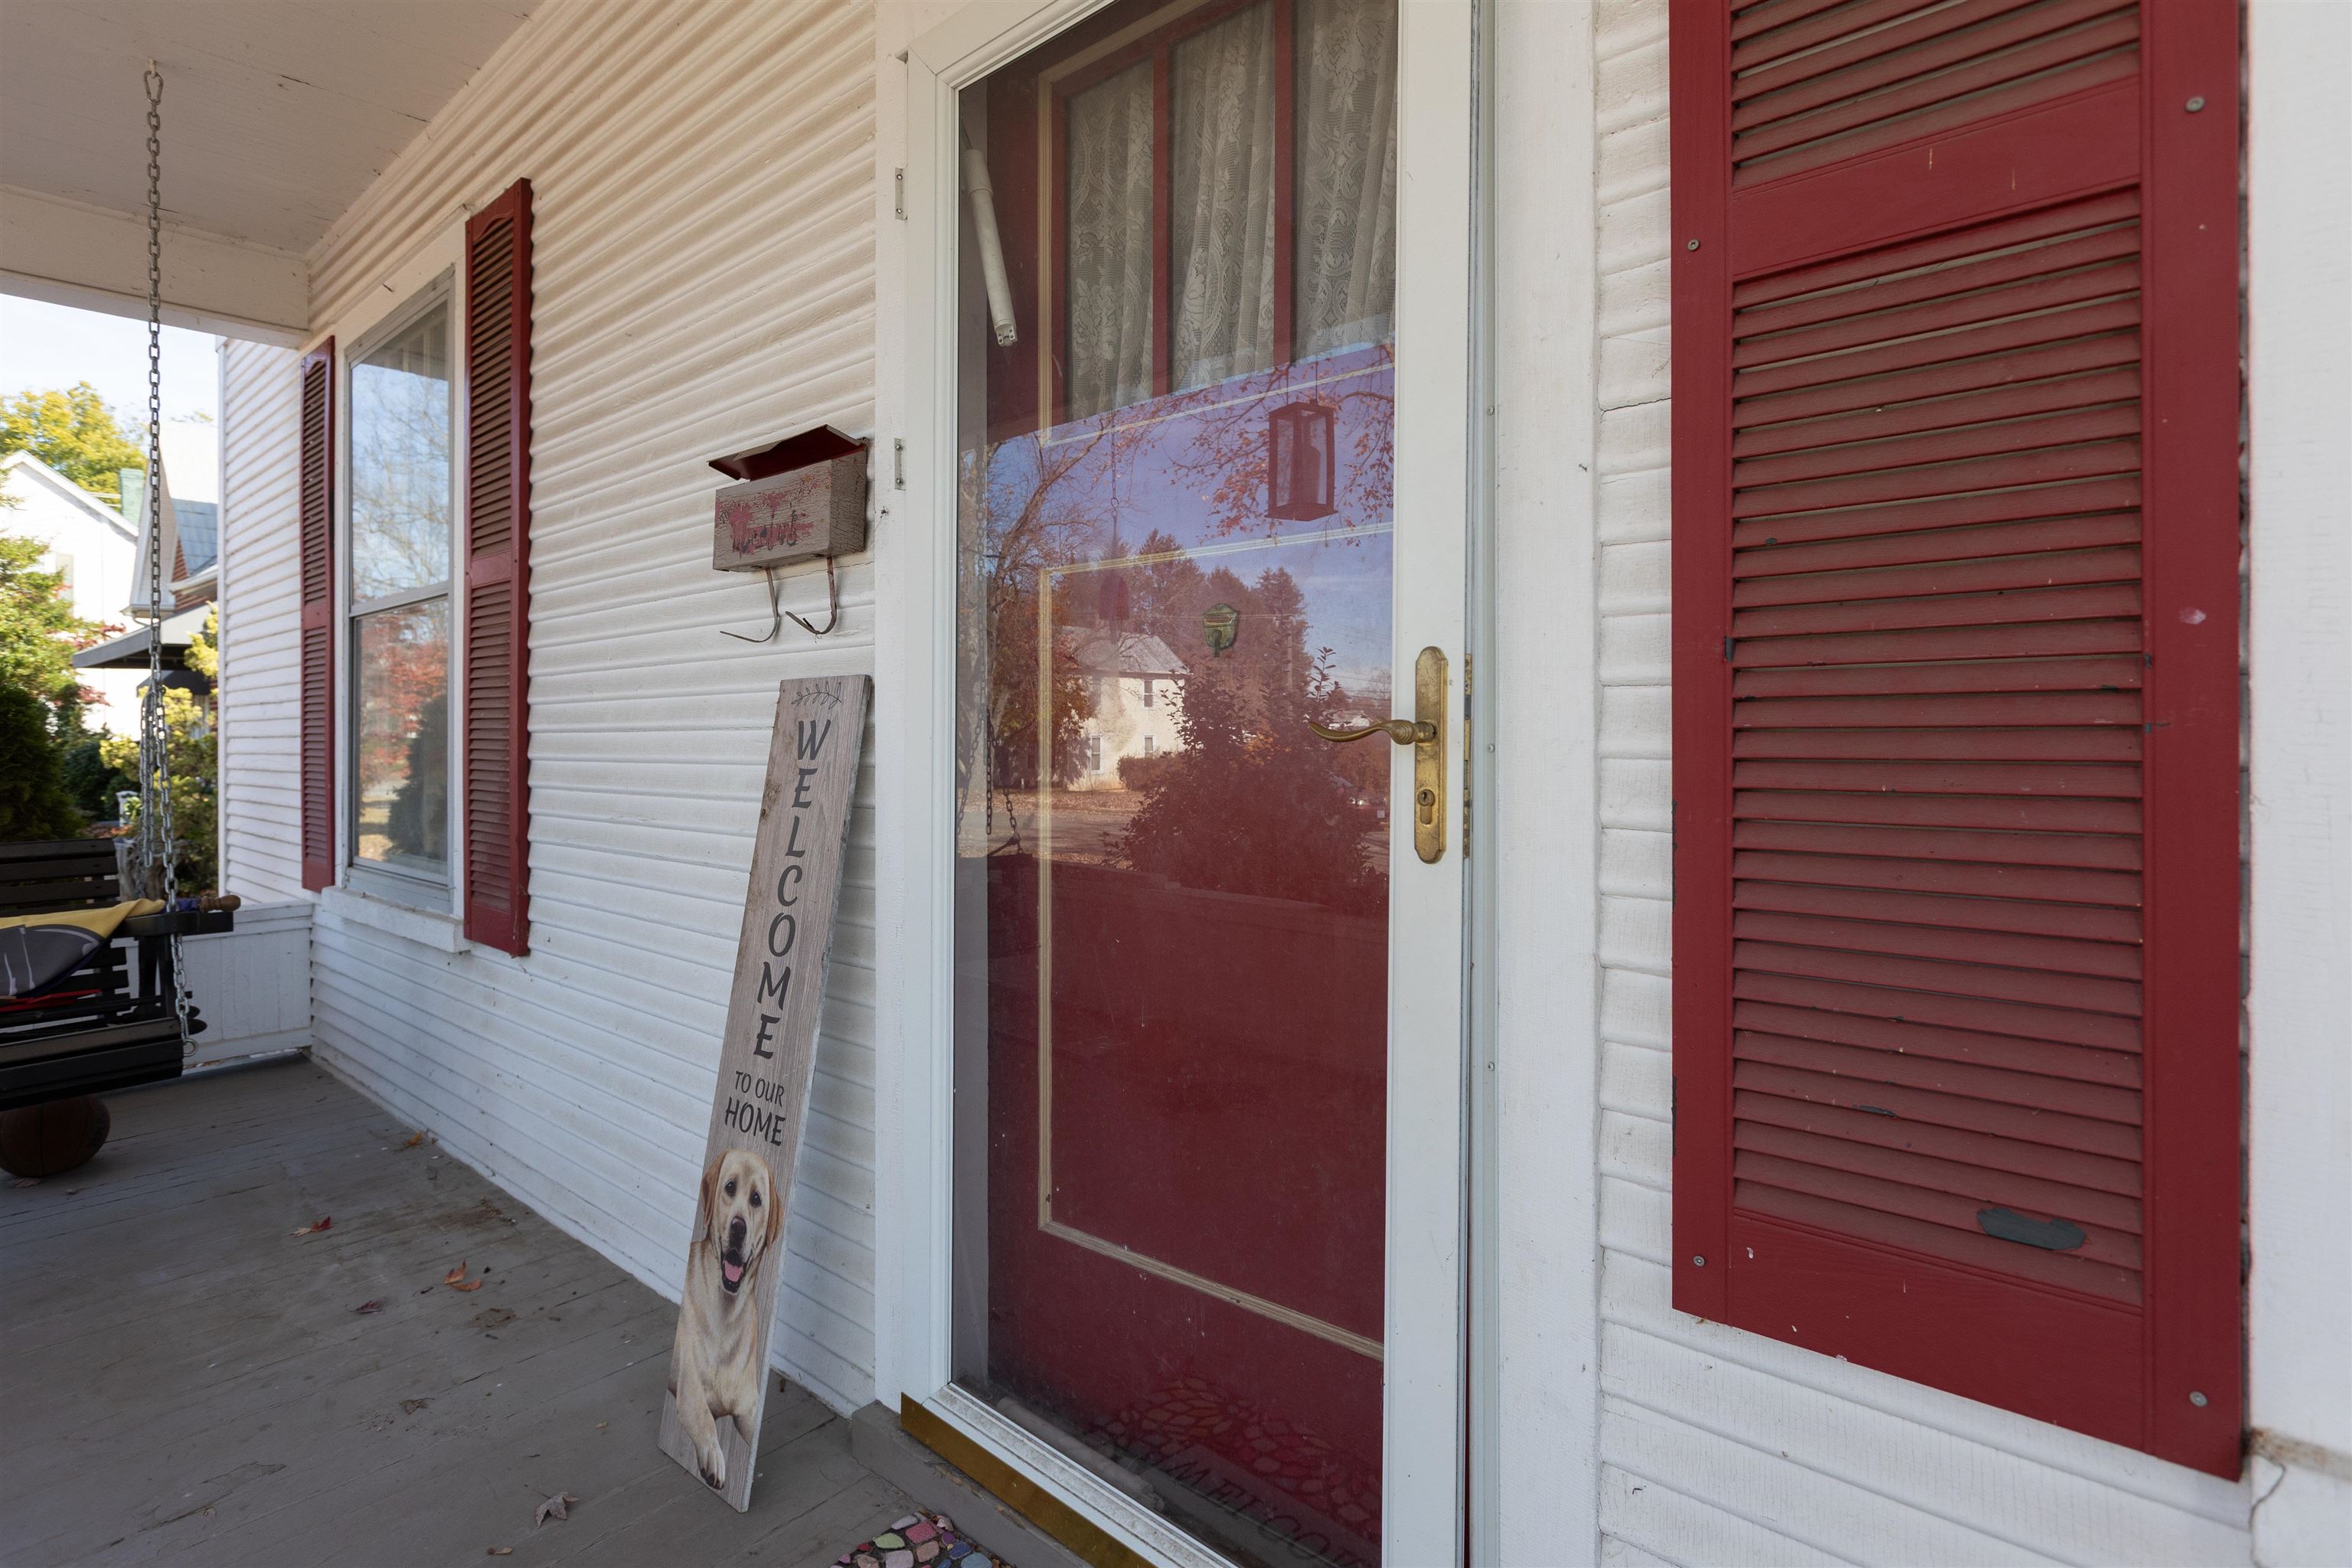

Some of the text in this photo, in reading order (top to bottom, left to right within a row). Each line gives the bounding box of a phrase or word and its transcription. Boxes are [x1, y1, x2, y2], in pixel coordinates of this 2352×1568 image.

[753, 719, 831, 1060] WELCOME
[735, 1070, 785, 1108] TO OUR
[724, 1096, 786, 1147] HOME
